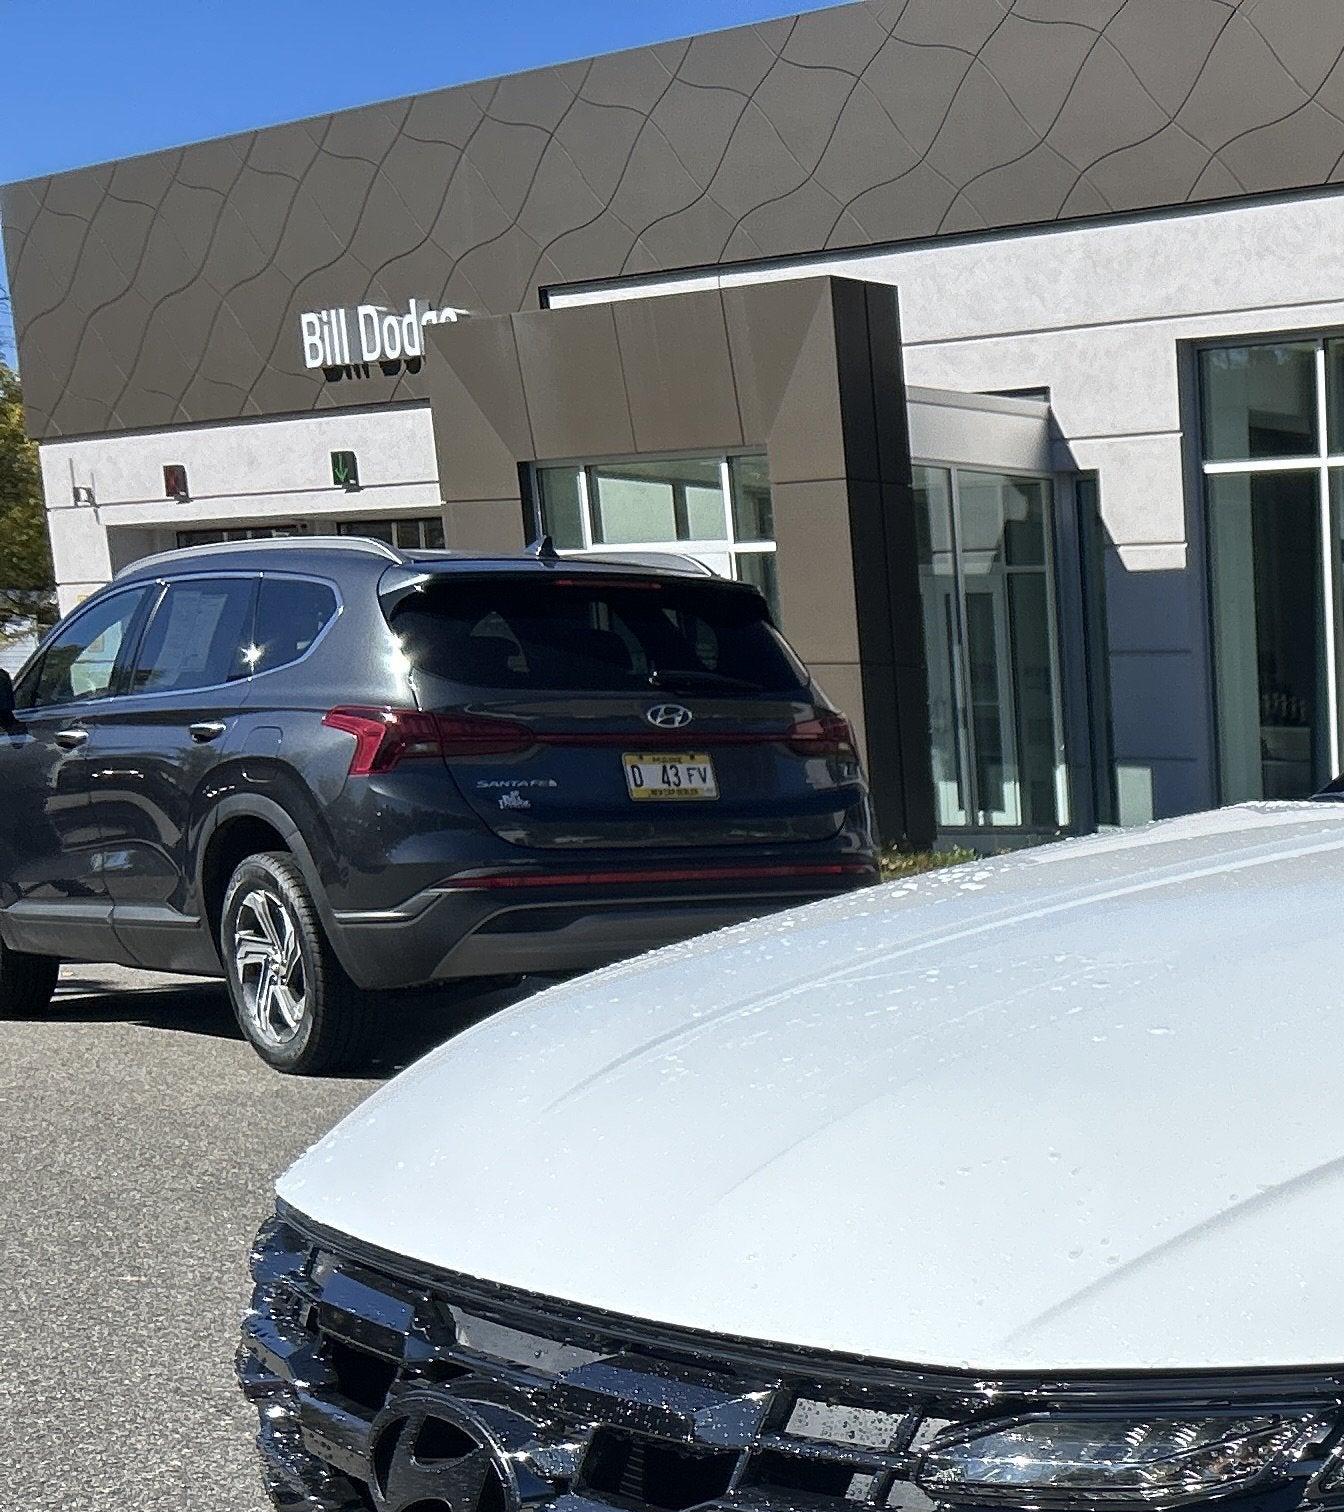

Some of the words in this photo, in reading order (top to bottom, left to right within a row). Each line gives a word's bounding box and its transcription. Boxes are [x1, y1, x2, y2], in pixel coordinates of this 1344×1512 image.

[301, 308, 350, 369] Bill
[357, 299, 458, 361] Dod
[661, 764, 681, 787] 43
[686, 767, 707, 784] FV
